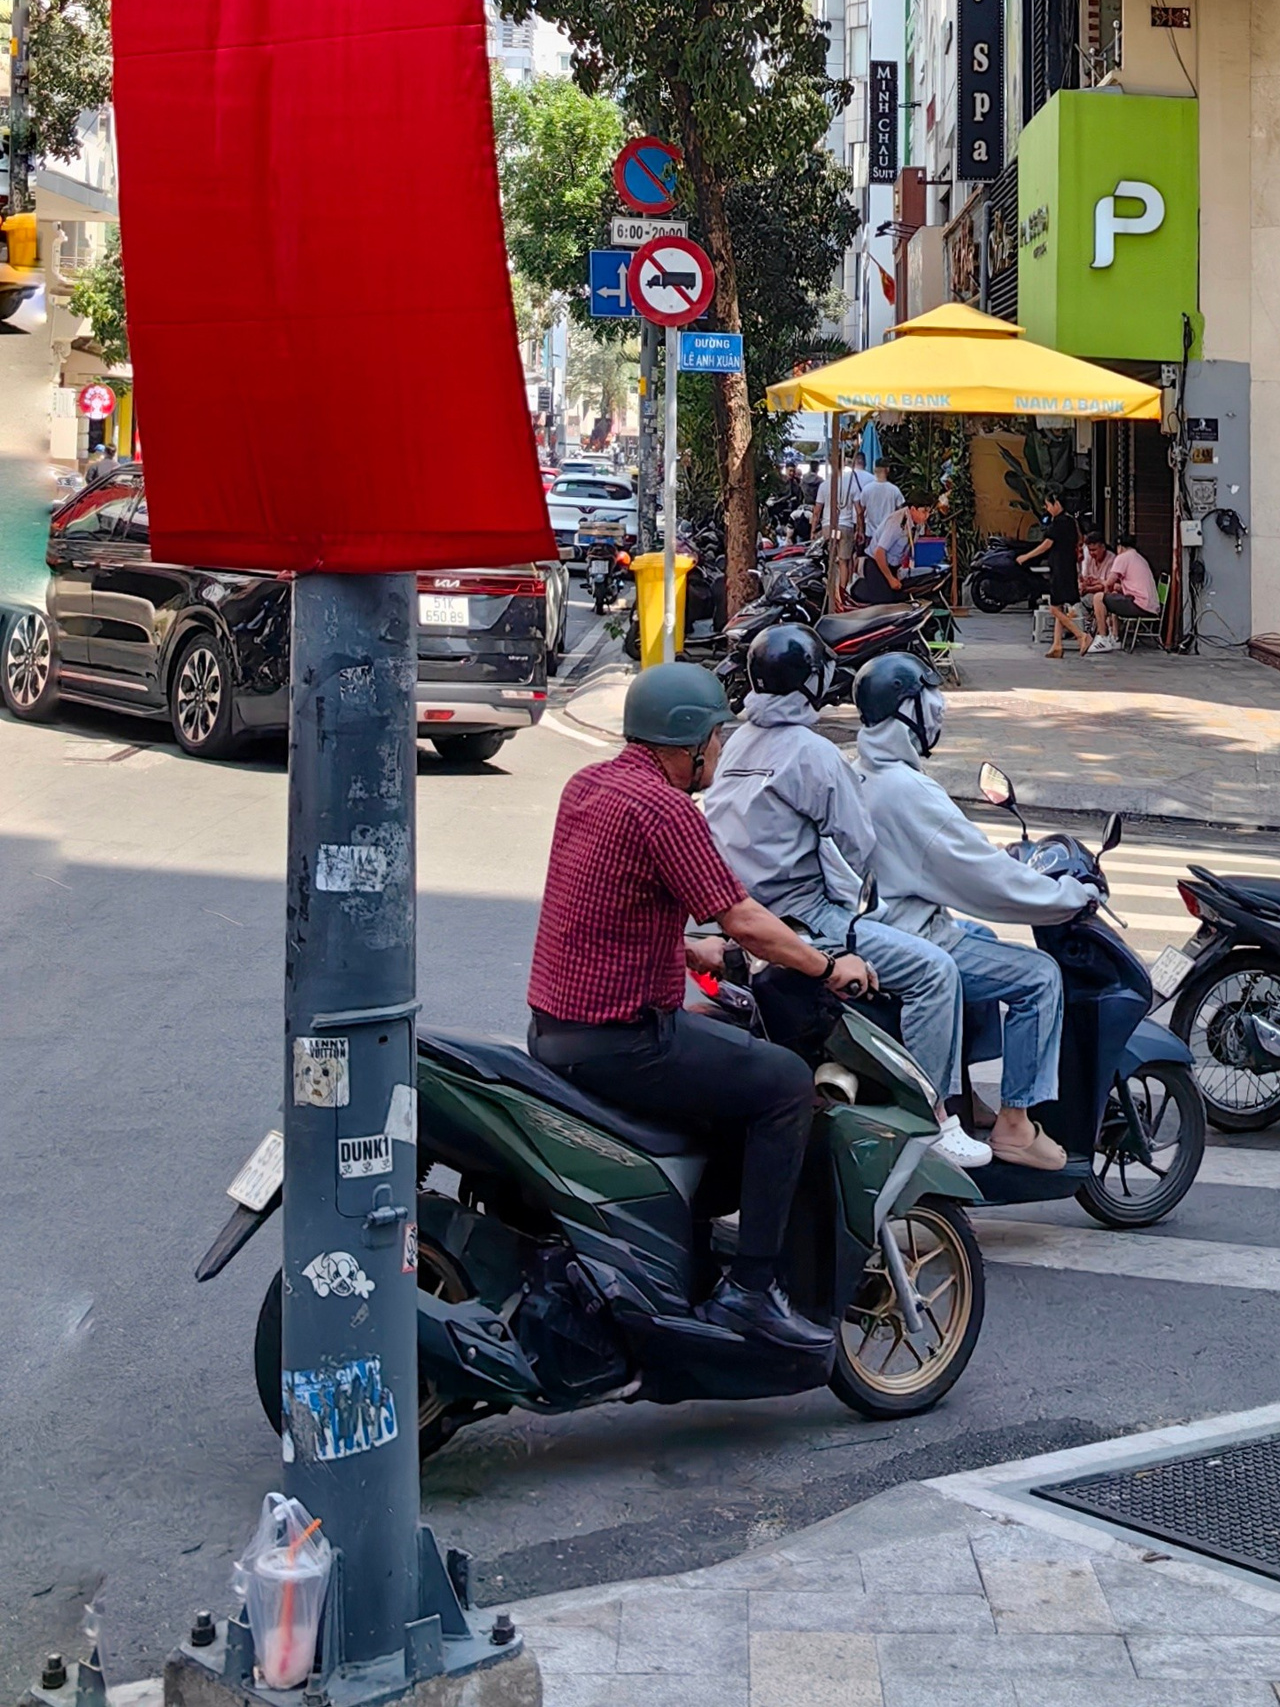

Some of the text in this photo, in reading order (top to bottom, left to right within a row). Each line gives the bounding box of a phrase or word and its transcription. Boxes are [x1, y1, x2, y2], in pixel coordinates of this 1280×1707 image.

[695, 337, 730, 350] ĐƯỜNG
[697, 355, 715, 369] ANH
[837, 393, 951, 408] NAM A BANK
[1014, 395, 1125, 414] NAM A BANK
[341, 1142, 389, 1162] DUNK1
